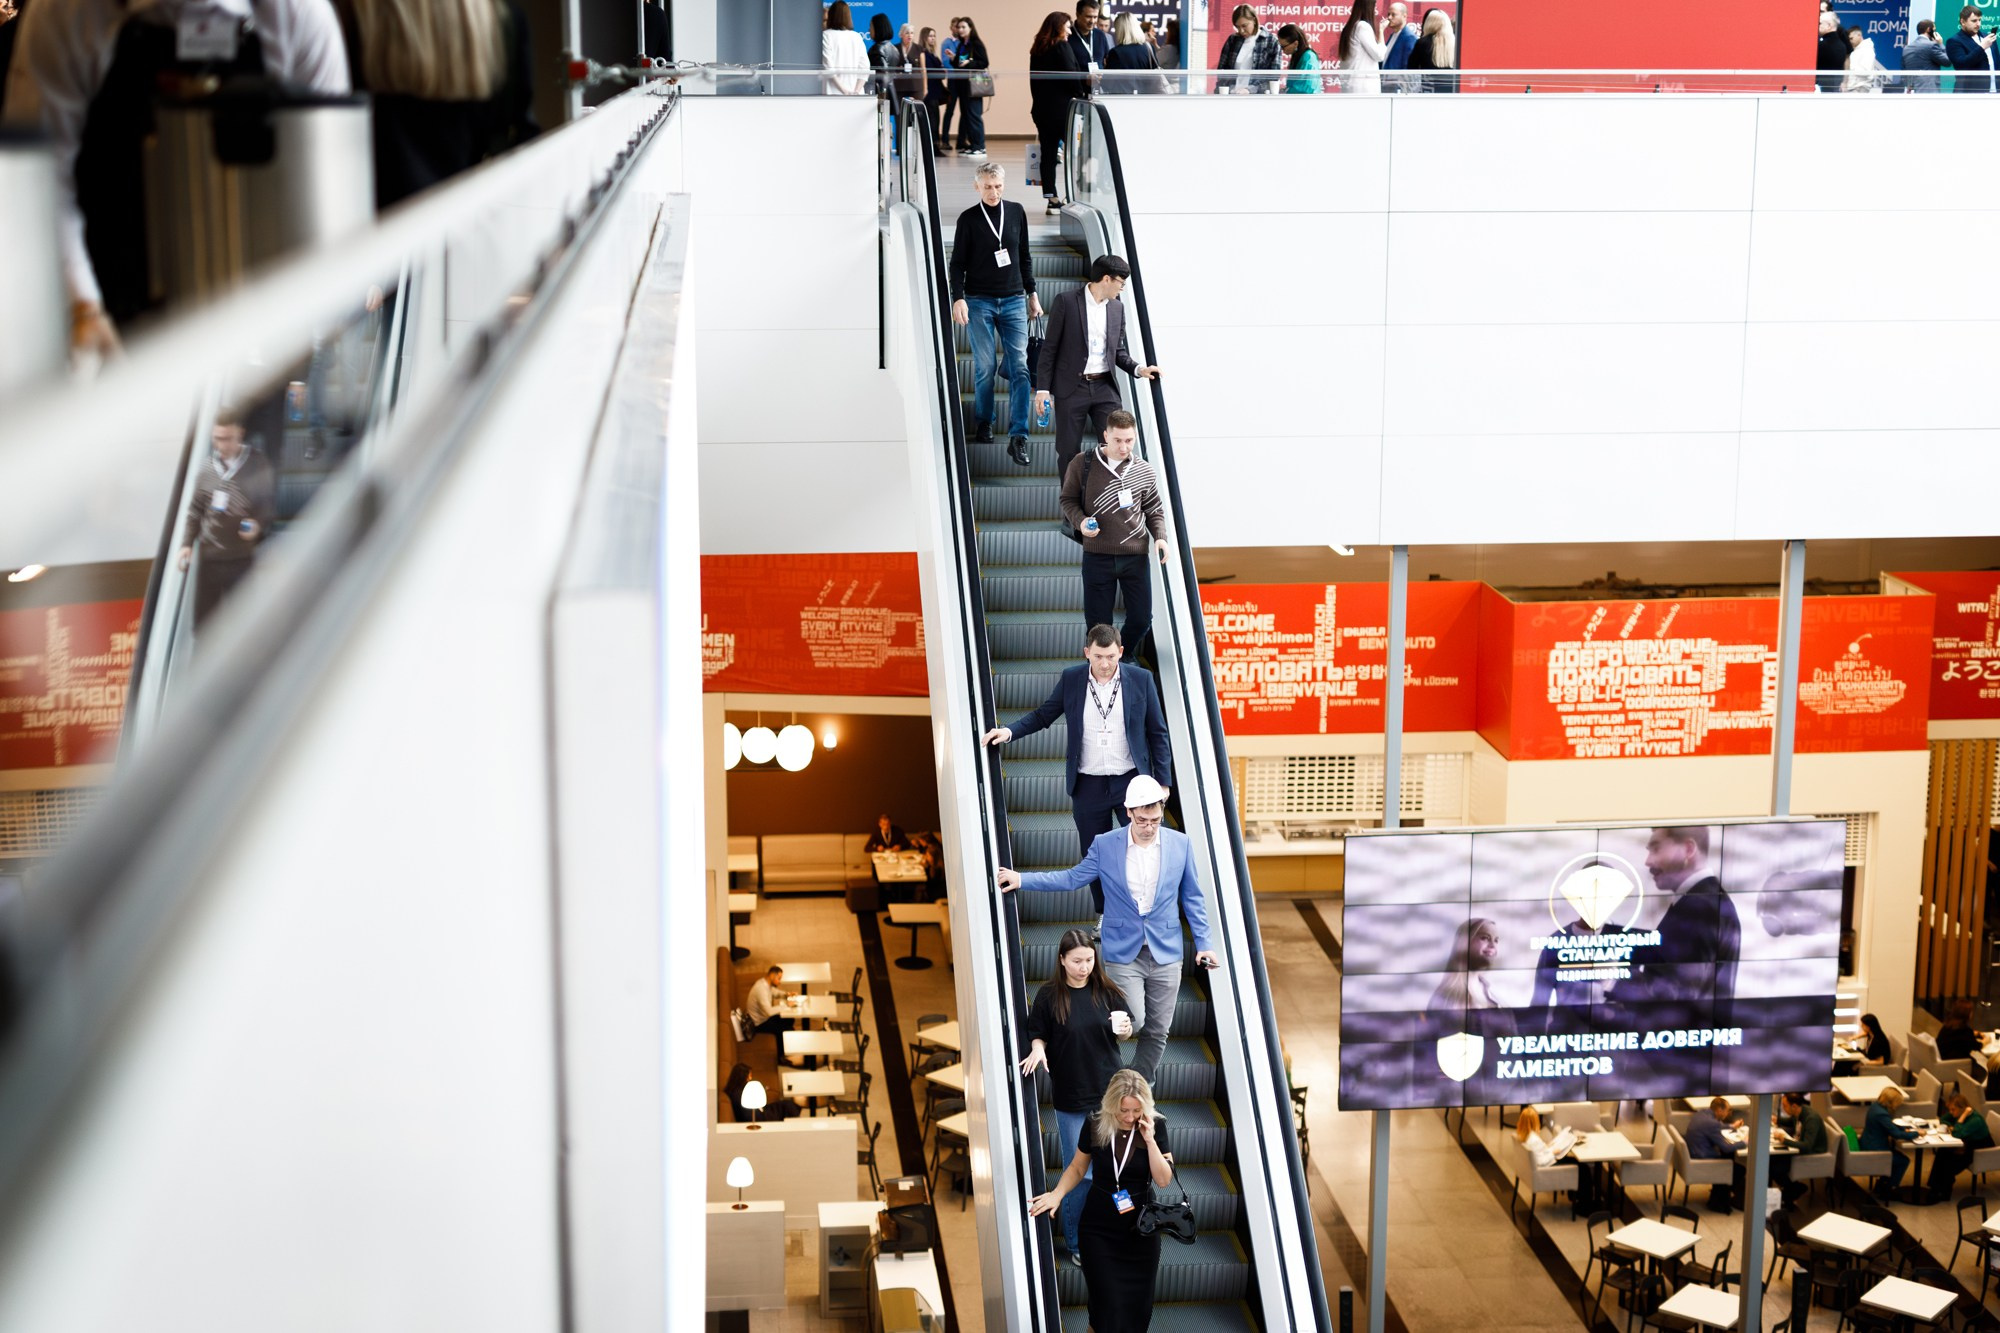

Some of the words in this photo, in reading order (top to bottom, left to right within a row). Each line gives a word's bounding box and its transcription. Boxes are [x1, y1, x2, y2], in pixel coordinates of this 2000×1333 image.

[1303, 5, 1351, 16] ИПОТЕК
[1203, 613, 1276, 632] ELCOME
[1623, 638, 1712, 654] BIENVENUE
[1548, 648, 1623, 668] ДОБРО
[1625, 650, 1683, 666] WELCOME
[1212, 660, 1344, 683] ЖАЛОВАТЬ
[1548, 664, 1702, 688] ПОЖАЛОВАТЬ
[1266, 680, 1358, 699] BIENVENUE
[1575, 743, 1621, 757] SVEIKI
[1530, 930, 1661, 950] БРИЛЛИАНТОВЫЙ
[1557, 946, 1633, 962] СТАНДАРТ
[1497, 1032, 1639, 1055] УВЕЛИЧЕНИЕ
[1641, 1028, 1742, 1050] ДОВЕРИЯ
[1497, 1056, 1613, 1079] КЛИЕНТОВ
